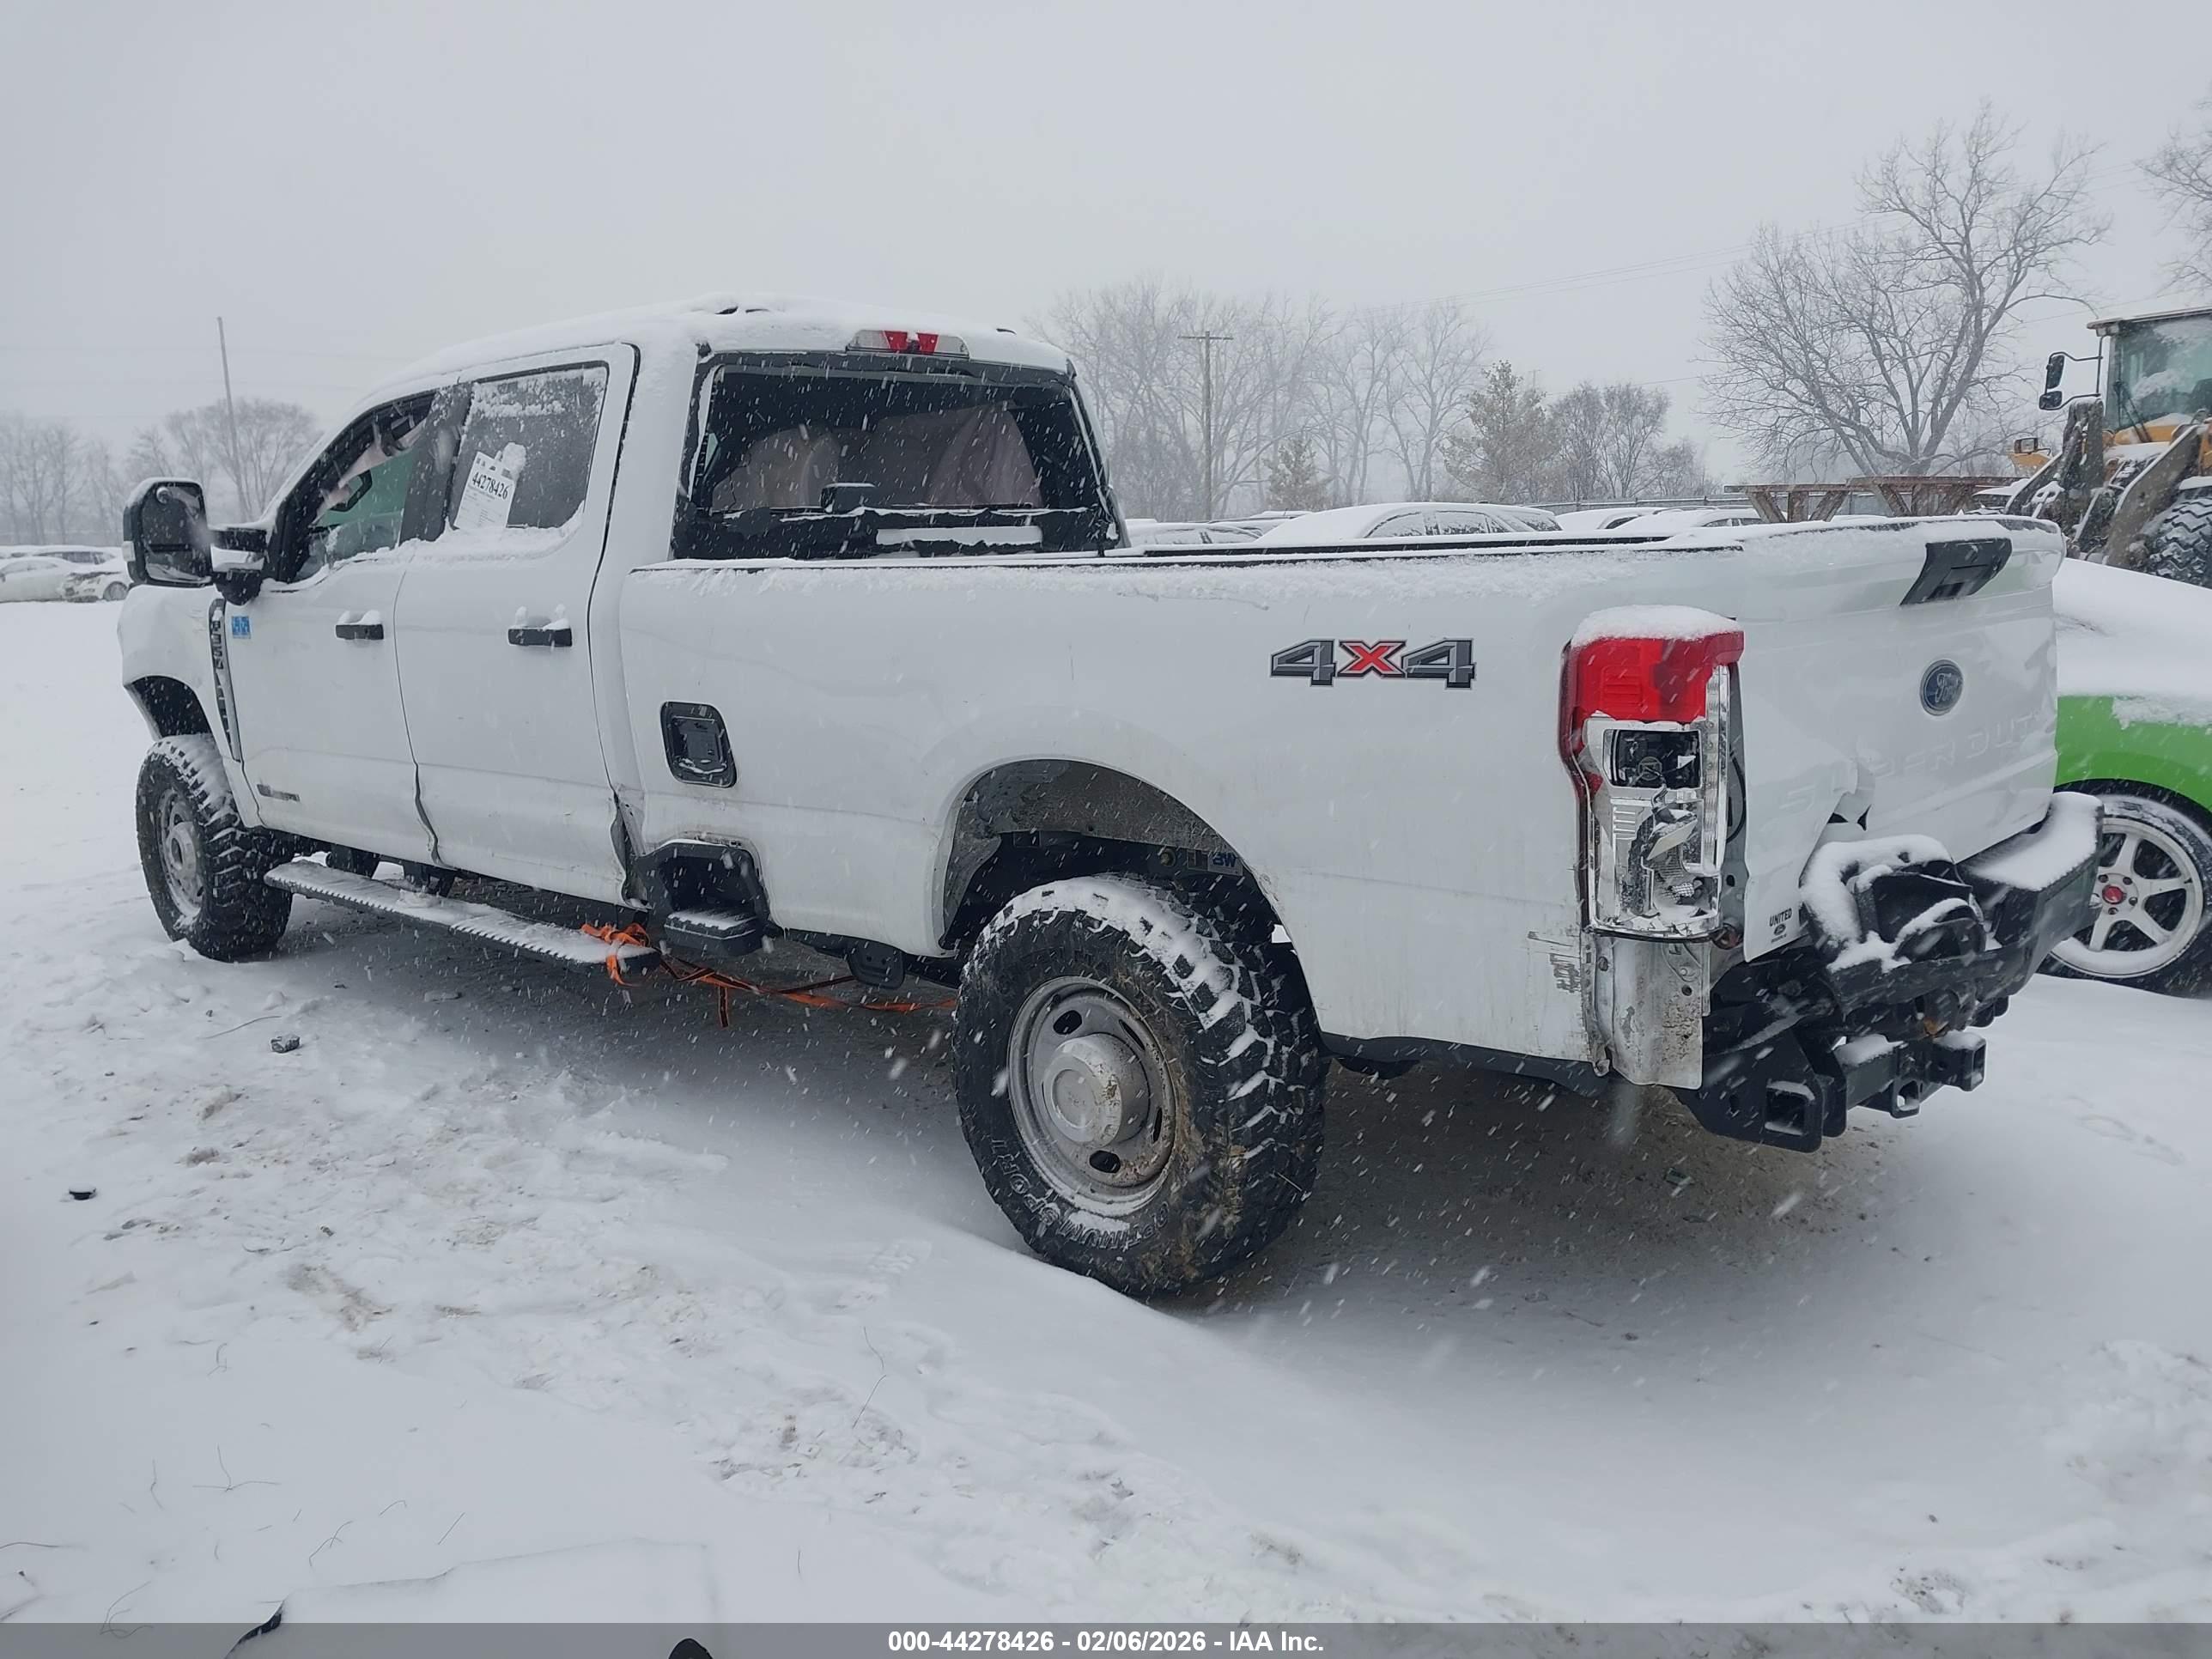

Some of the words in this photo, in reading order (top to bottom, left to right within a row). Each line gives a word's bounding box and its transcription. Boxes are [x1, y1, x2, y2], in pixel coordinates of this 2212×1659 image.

[472, 471, 508, 500] 44278426
[1966, 708, 2055, 759] DUT
[1770, 908, 1792, 927] UNITED
